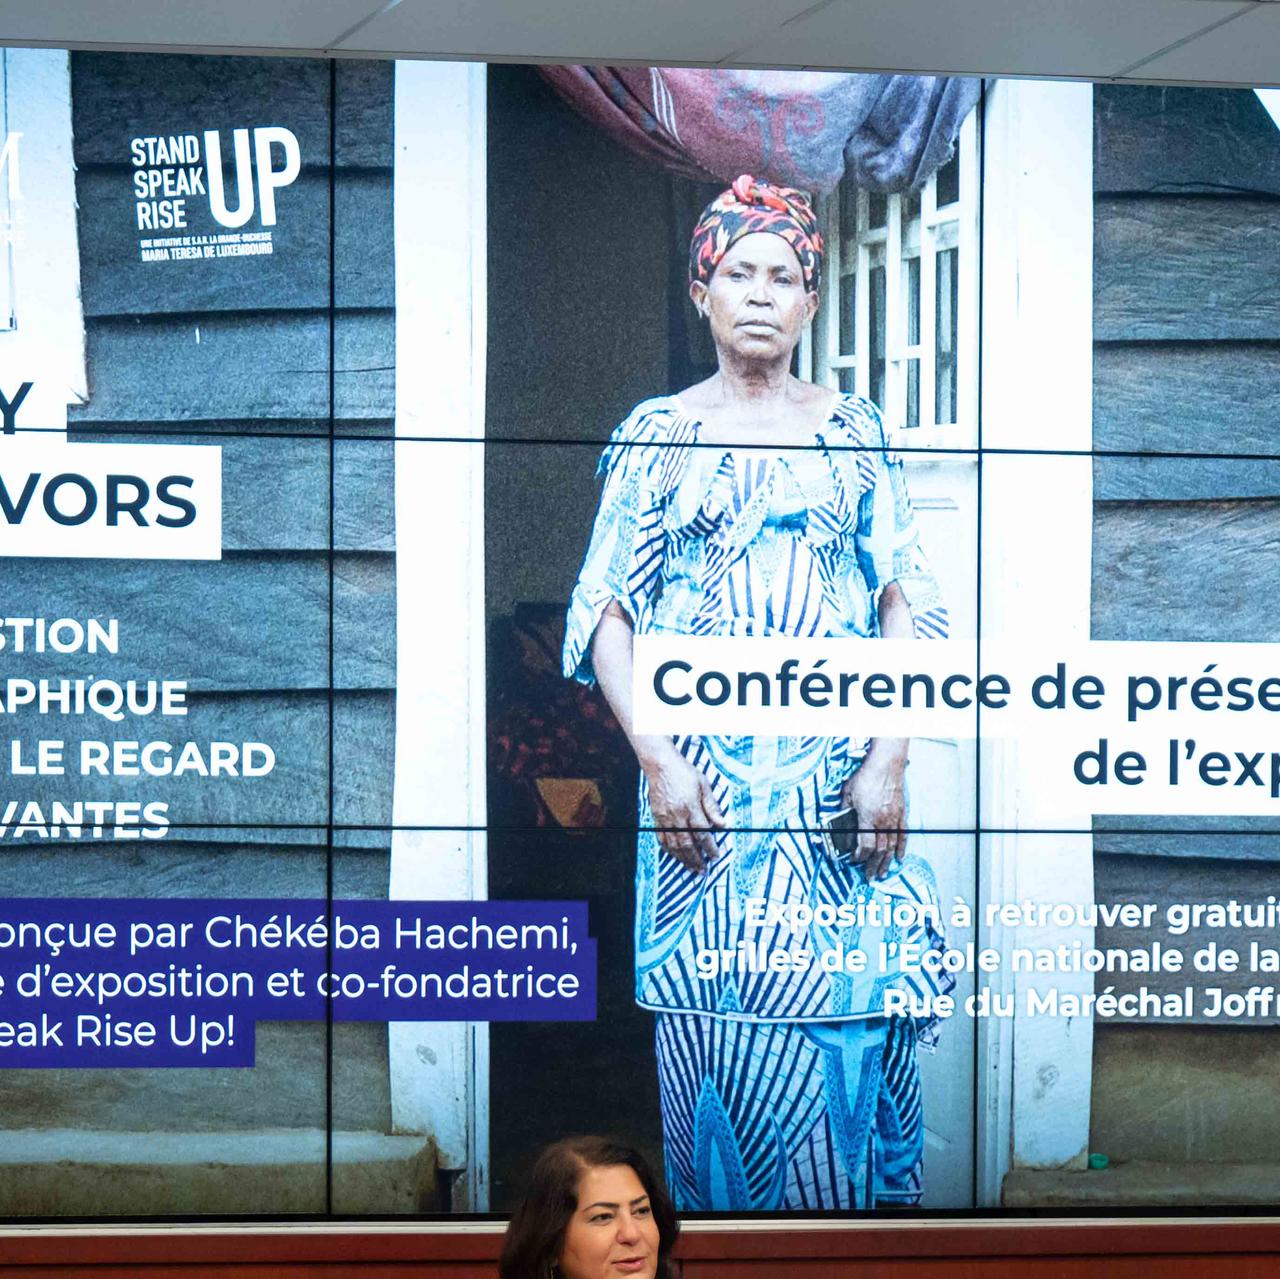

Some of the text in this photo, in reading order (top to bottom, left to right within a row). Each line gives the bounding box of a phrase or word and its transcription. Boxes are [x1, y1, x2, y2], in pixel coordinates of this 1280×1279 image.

[130, 135, 200, 167] STAND
[133, 166, 207, 199] SPEAK
[203, 126, 302, 229] UP
[136, 199, 188, 231] RISE
[141, 242, 273, 262] MARIA TERESA DE LUXEMBOURG
[652, 658, 1011, 709] Conférence
[1031, 663, 1105, 710] de
[11, 740, 65, 775] LE
[80, 740, 276, 777] REGARD
[1073, 738, 1147, 785] de
[744, 897, 939, 934] Exposition
[950, 898, 971, 928] à
[985, 900, 1157, 928] retrouver
[130, 921, 194, 955] par
[205, 915, 381, 949] Chékéba
[394, 917, 578, 955] Hachemi,
[696, 941, 811, 979] grilles
[820, 942, 868, 972] de
[1011, 942, 1183, 973] nationale
[1193, 942, 1240, 972] de
[1250, 942, 1280, 972] la
[16, 964, 254, 1005] d’exposition
[266, 971, 305, 998] et
[316, 965, 580, 998] co-fondatrice
[883, 988, 956, 1018] Rue
[964, 987, 1015, 1018] du
[1026, 987, 1194, 1018] Maréchal
[76, 1014, 157, 1047] Rise
[169, 1014, 236, 1054] Up!
